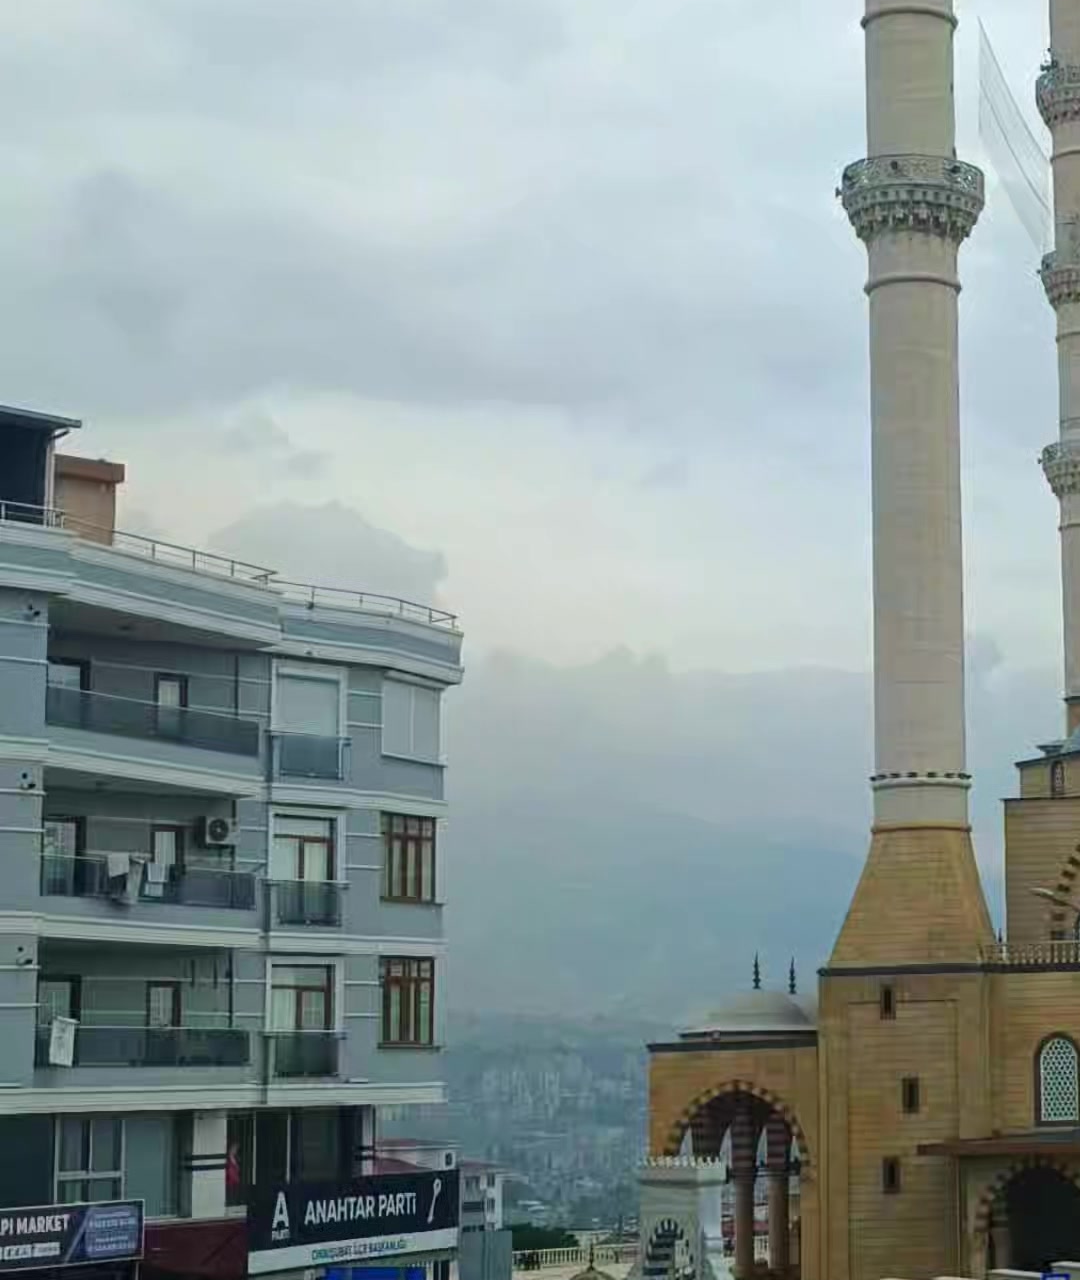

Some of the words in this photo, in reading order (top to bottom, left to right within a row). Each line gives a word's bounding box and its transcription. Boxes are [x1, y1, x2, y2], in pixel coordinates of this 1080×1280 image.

[304, 1195, 375, 1226] ANAHTAR
[0, 1217, 14, 1236] PI
[16, 1213, 70, 1235] MARKET
